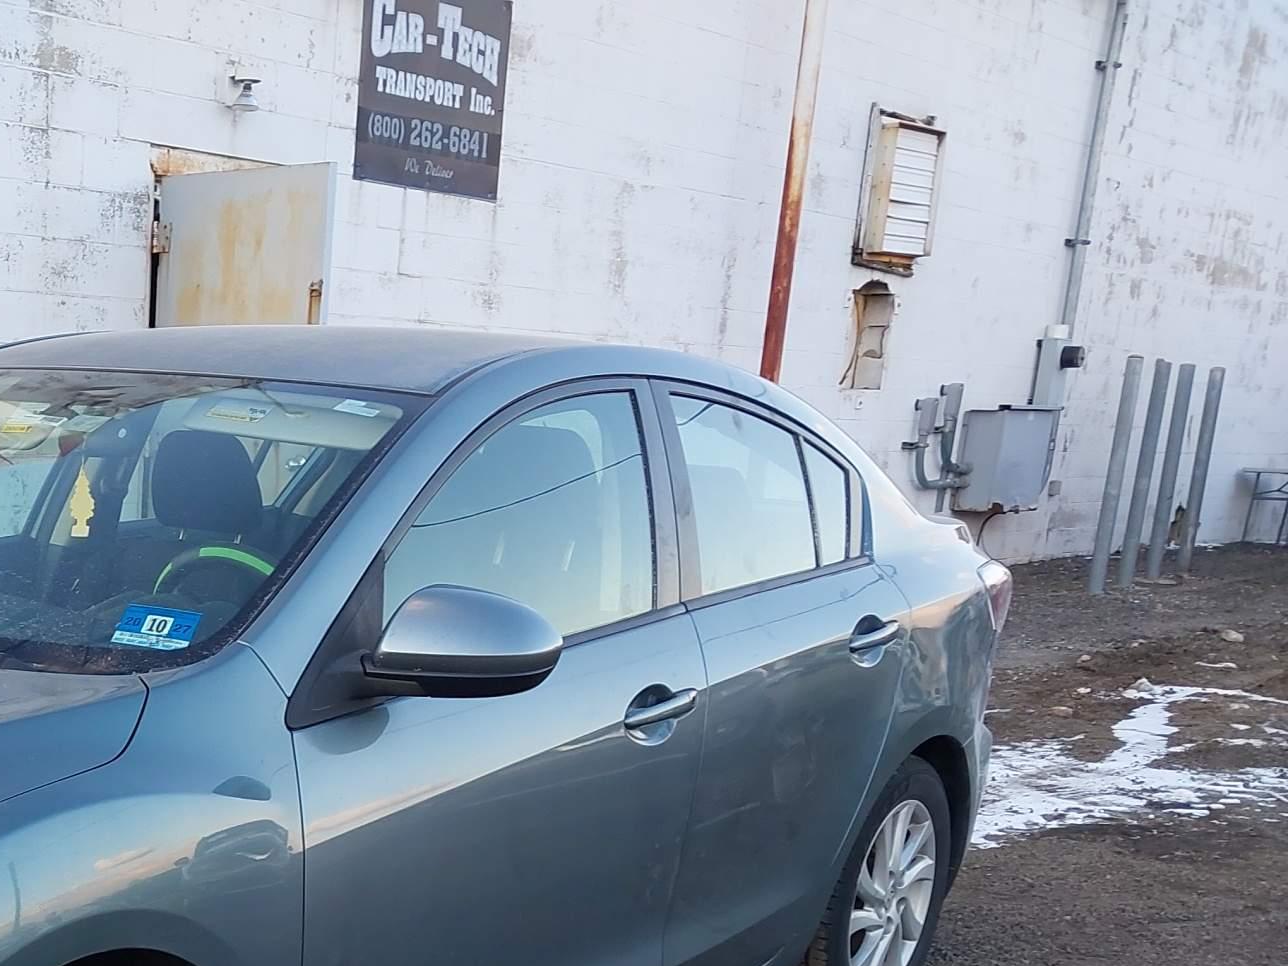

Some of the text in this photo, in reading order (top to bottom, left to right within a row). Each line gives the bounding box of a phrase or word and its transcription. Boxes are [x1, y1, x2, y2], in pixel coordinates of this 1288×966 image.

[375, 65, 495, 116] TRANSPORT Inc.
[368, 112, 489, 158] (800) 262-6841
[124, 616, 192, 634] 20 10 27
